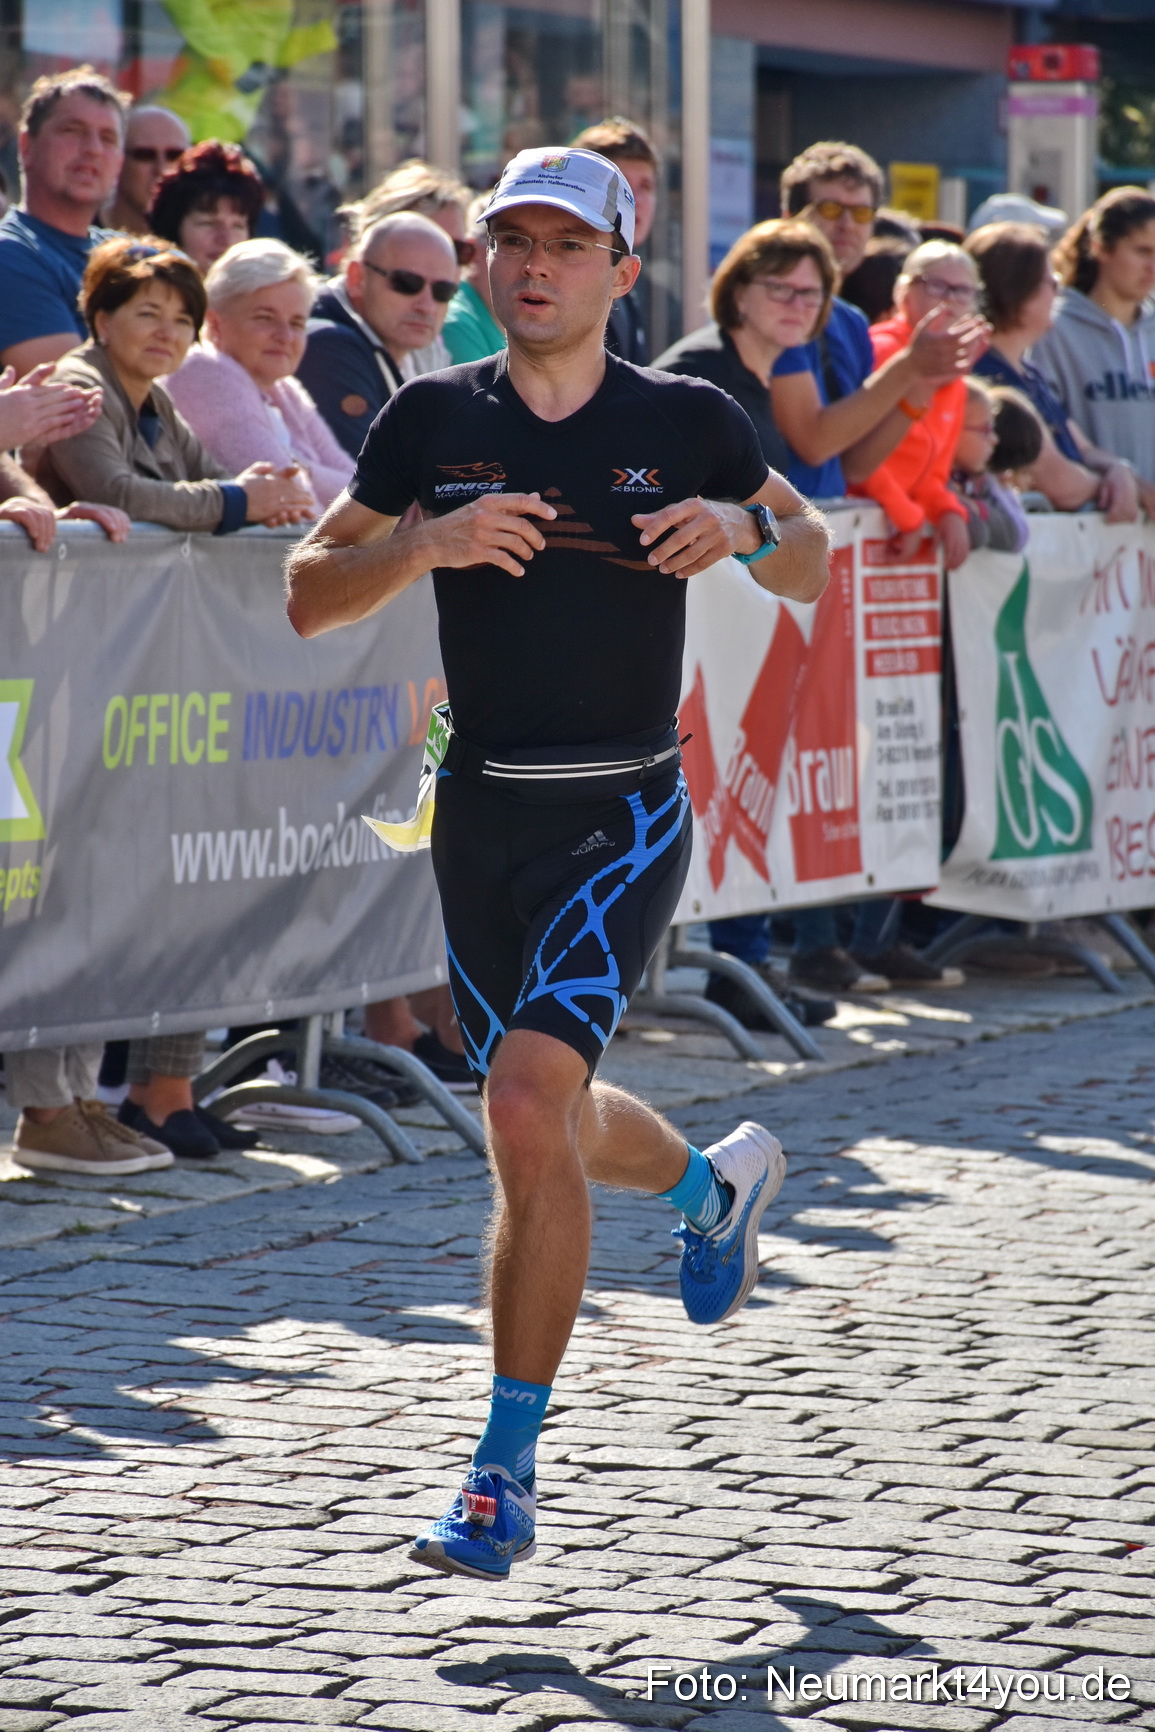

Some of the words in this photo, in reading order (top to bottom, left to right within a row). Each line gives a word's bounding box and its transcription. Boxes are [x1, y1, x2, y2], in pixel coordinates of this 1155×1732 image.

[547, 179, 586, 193] Halbmarathon
[1083, 370, 1155, 401] elle
[435, 482, 506, 493] VENICE
[102, 691, 232, 770] OFFICE
[242, 683, 401, 762] INDUSTRY
[784, 732, 853, 817] Braun
